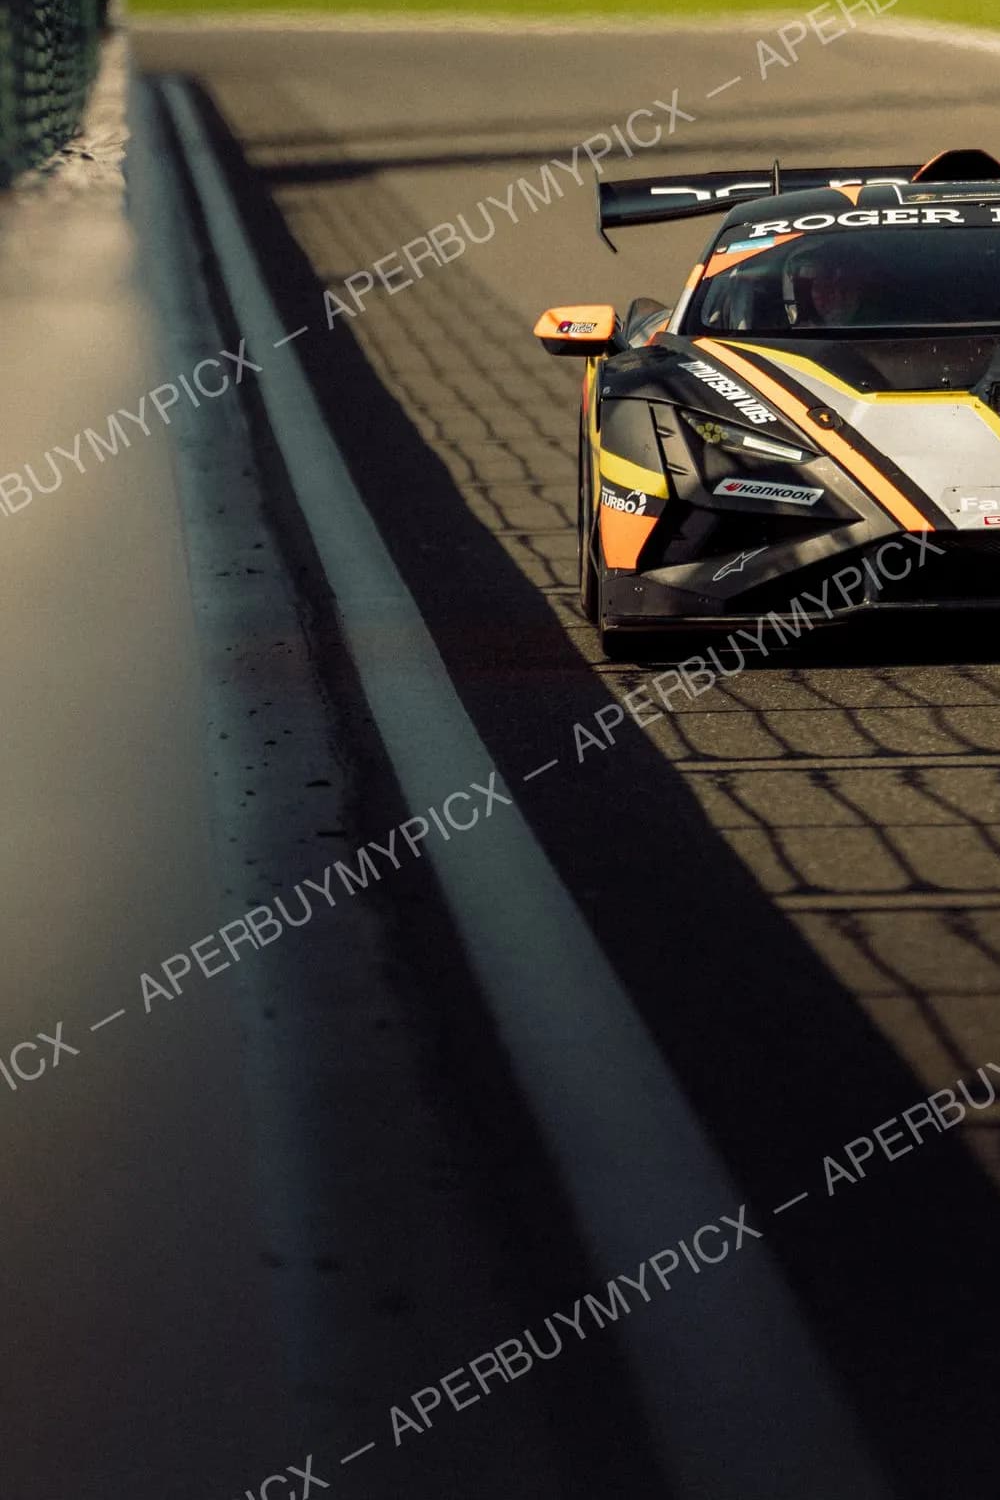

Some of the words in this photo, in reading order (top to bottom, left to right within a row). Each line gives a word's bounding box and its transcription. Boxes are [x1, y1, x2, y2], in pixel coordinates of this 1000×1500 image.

[748, 207, 966, 239] ROGER
[677, 359, 751, 401] BOUTSEN
[733, 397, 778, 425] VDS
[602, 491, 637, 514] TURBO
